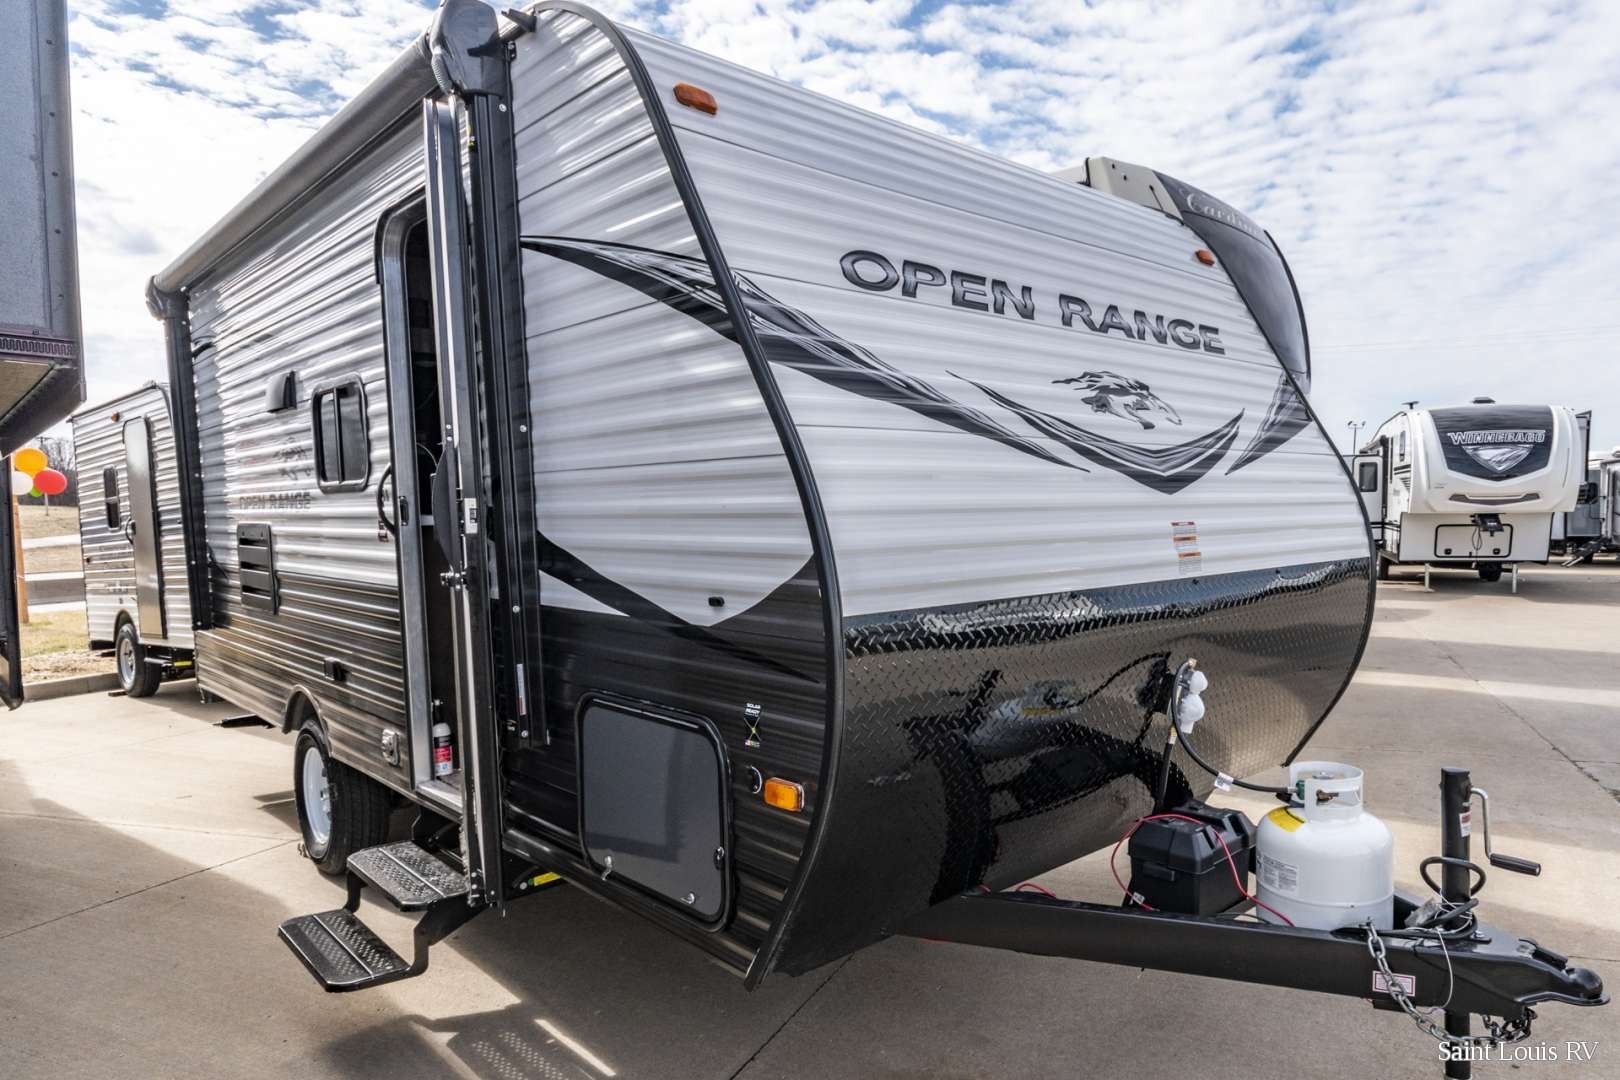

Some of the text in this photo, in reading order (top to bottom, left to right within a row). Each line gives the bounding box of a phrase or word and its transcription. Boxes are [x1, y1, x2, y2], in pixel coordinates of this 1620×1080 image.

[839, 249, 1226, 355] OPEN RANGE
[1446, 429, 1546, 445] WINNEBAGO
[239, 491, 311, 510] OPEN RANGE
